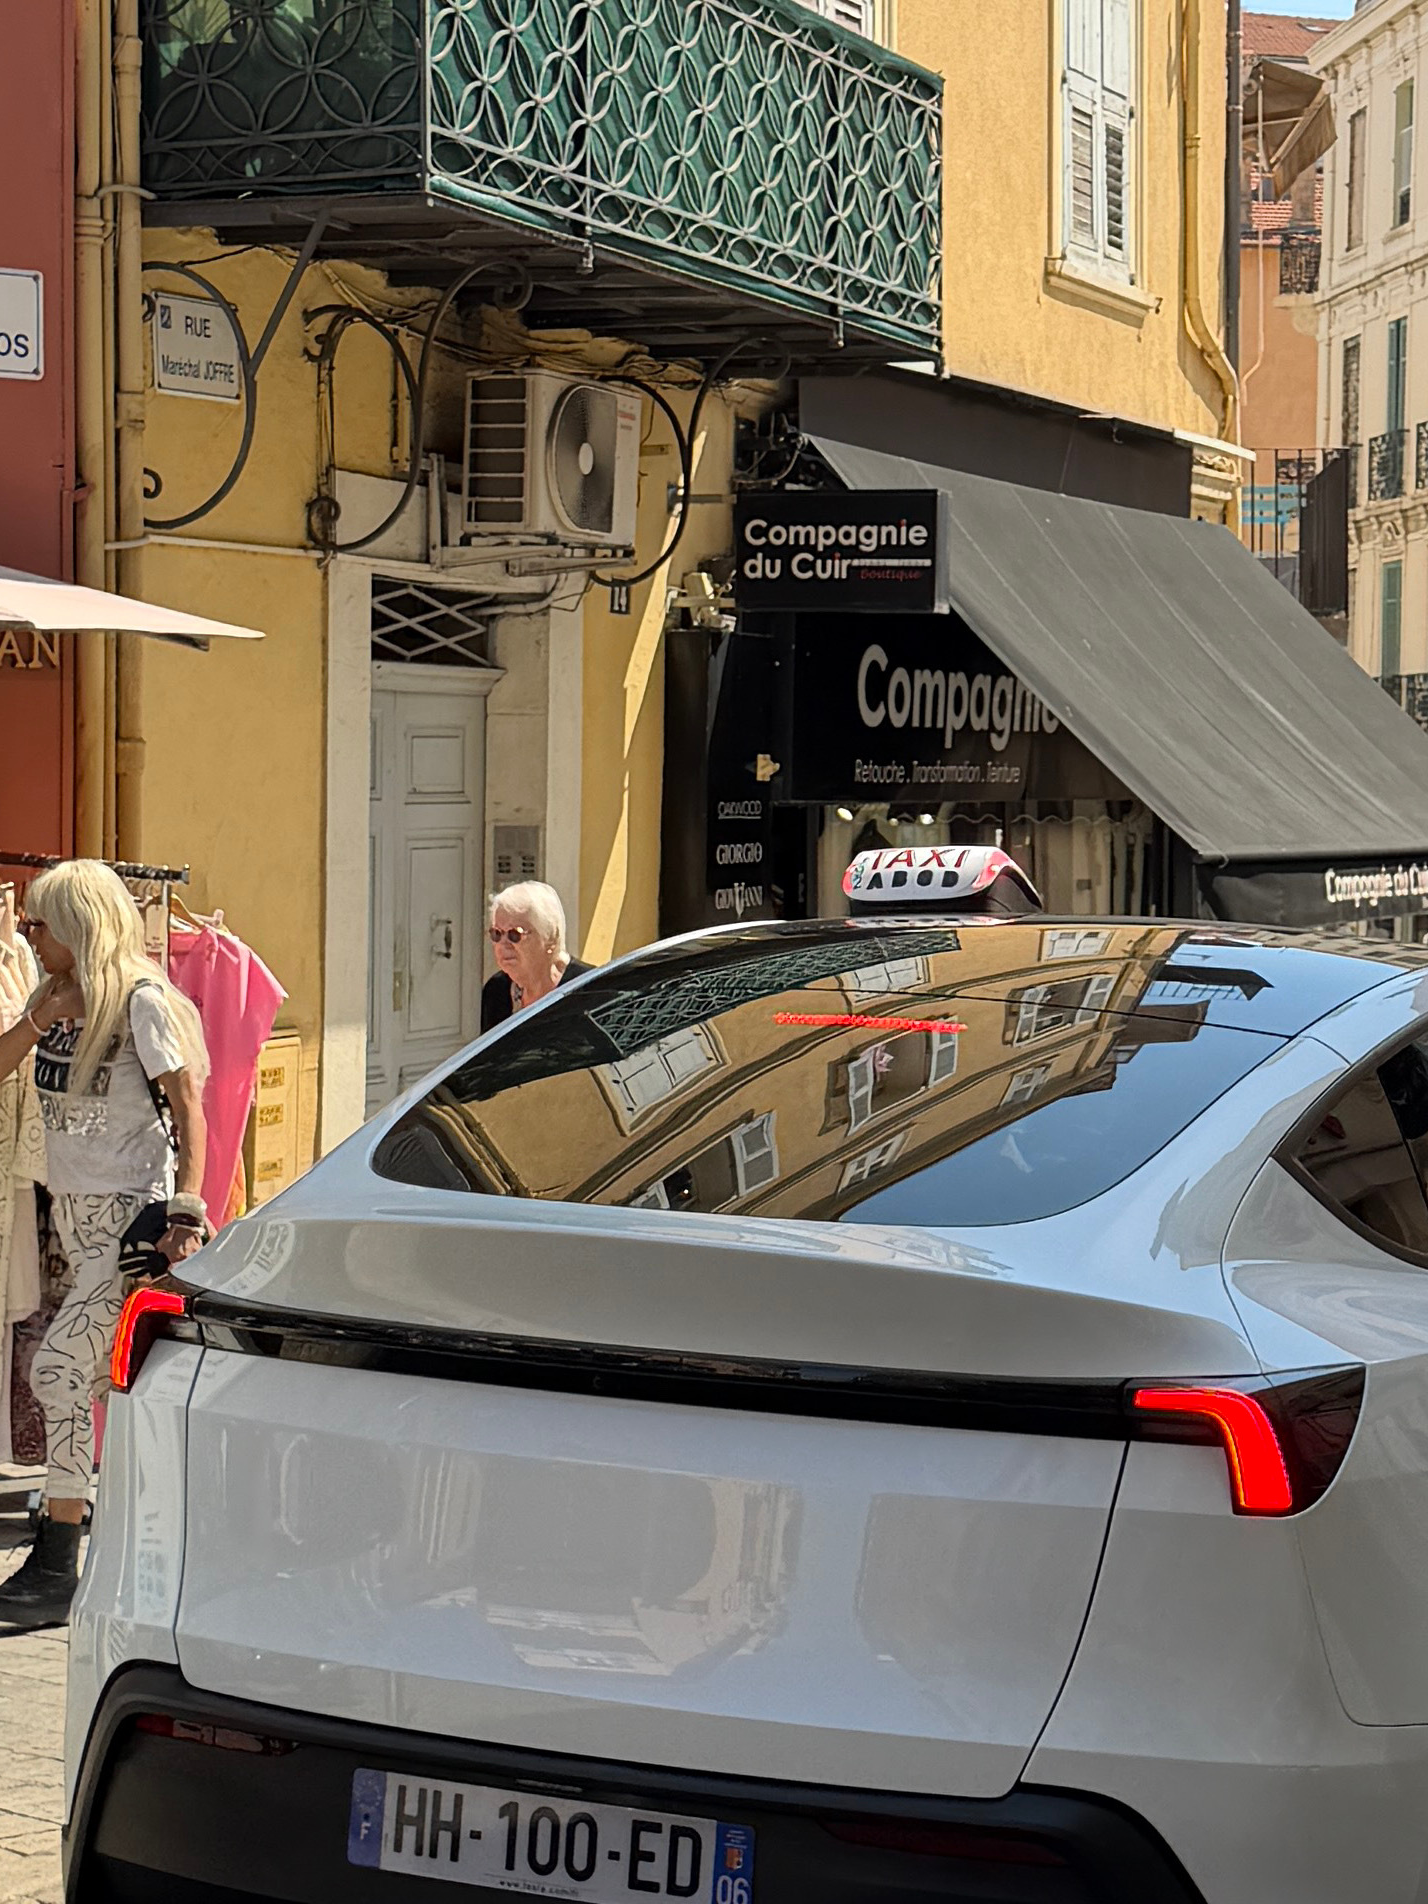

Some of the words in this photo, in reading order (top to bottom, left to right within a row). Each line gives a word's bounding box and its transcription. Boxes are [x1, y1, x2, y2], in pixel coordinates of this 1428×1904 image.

[185, 316, 211, 338] RUE
[162, 354, 201, 379] Maréchal
[203, 360, 234, 384] JOFFRE
[744, 518, 929, 552] Compagnie
[743, 552, 782, 579] du
[791, 552, 852, 580] Cuir
[854, 759, 905, 783] Retouche
[912, 760, 980, 783] Transformation
[716, 842, 763, 865] GIORGIO
[871, 849, 971, 870] TAXI
[360, 1822, 371, 1840] F
[393, 1784, 703, 1899] HH-100-ED
